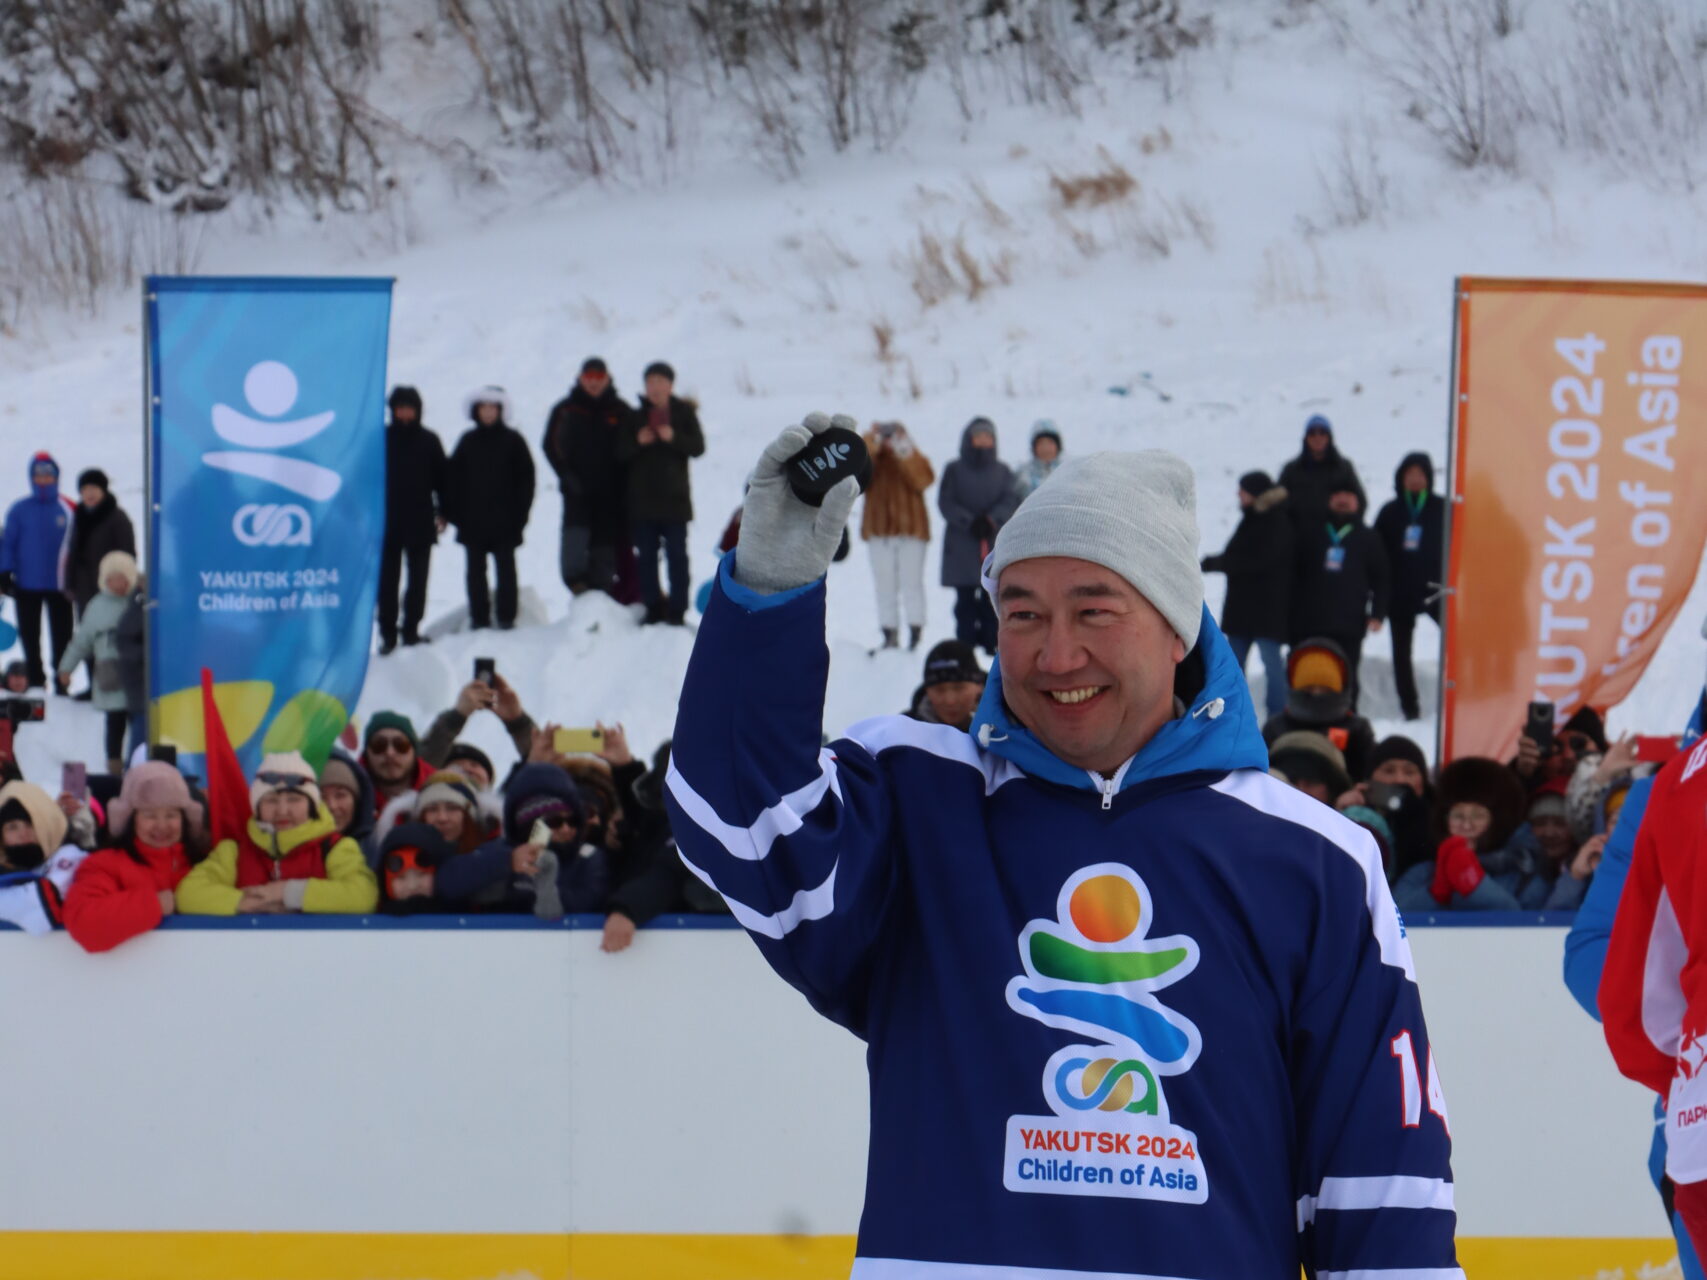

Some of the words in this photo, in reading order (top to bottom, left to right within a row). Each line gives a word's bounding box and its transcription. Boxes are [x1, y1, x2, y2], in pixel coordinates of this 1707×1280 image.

[1546, 332, 1606, 501] 2024
[1622, 334, 1683, 472] Asia
[1618, 480, 1673, 547] of
[199, 592, 276, 612] Children
[280, 592, 298, 609] of
[301, 590, 340, 609] Asia
[200, 571, 289, 589] YAKUTSK
[293, 568, 339, 587] 2024
[1533, 515, 1597, 728] KUTSK
[1020, 1128, 1131, 1155] YAKUTSK
[1137, 1135, 1195, 1161] 2024
[1018, 1158, 1113, 1184] Children
[1120, 1163, 1145, 1185] of
[1149, 1166, 1198, 1191] Asia
